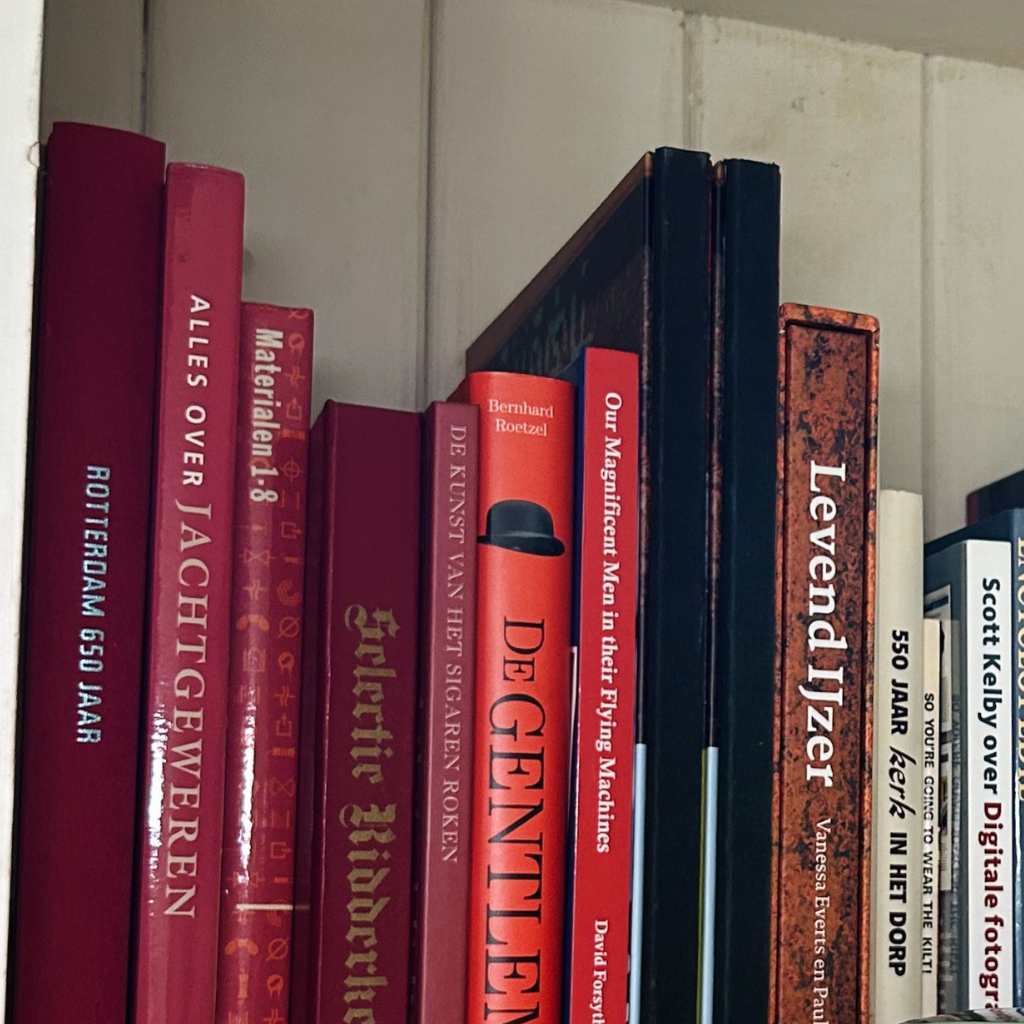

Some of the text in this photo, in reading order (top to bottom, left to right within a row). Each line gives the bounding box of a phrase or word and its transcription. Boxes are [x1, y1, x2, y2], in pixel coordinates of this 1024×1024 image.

[250, 328, 284, 459] Materialen
[488, 398, 554, 419] Bernhard
[495, 418, 548, 437] Roetzel
[75, 464, 111, 745] ROTTERDAM 650 JAAR
[166, 294, 212, 918] ALLES OVER JACHTGEWEREN
[441, 425, 468, 864] DE KUNST VAN HET SIGAREN ROKEN
[503, 617, 545, 682] DE
[595, 391, 622, 854] Our Magnificent Men in their Flying Machines
[802, 460, 847, 788] Levend IJzer
[982, 577, 1001, 646] Scott
[344, 606, 401, 784] Selectie
[977, 653, 1001, 729] Kelby
[888, 630, 916, 976] 550 JAAR kerk IN HET DORP
[982, 736, 999, 795] over
[814, 818, 832, 890] Vanessa
[922, 693, 935, 975] SO YOU'RE GOING TO WEAR THE KILT!
[978, 803, 1003, 909] Digitale
[594, 920, 608, 966] David
[813, 956, 829, 981] en
[814, 894, 830, 953] Everts
